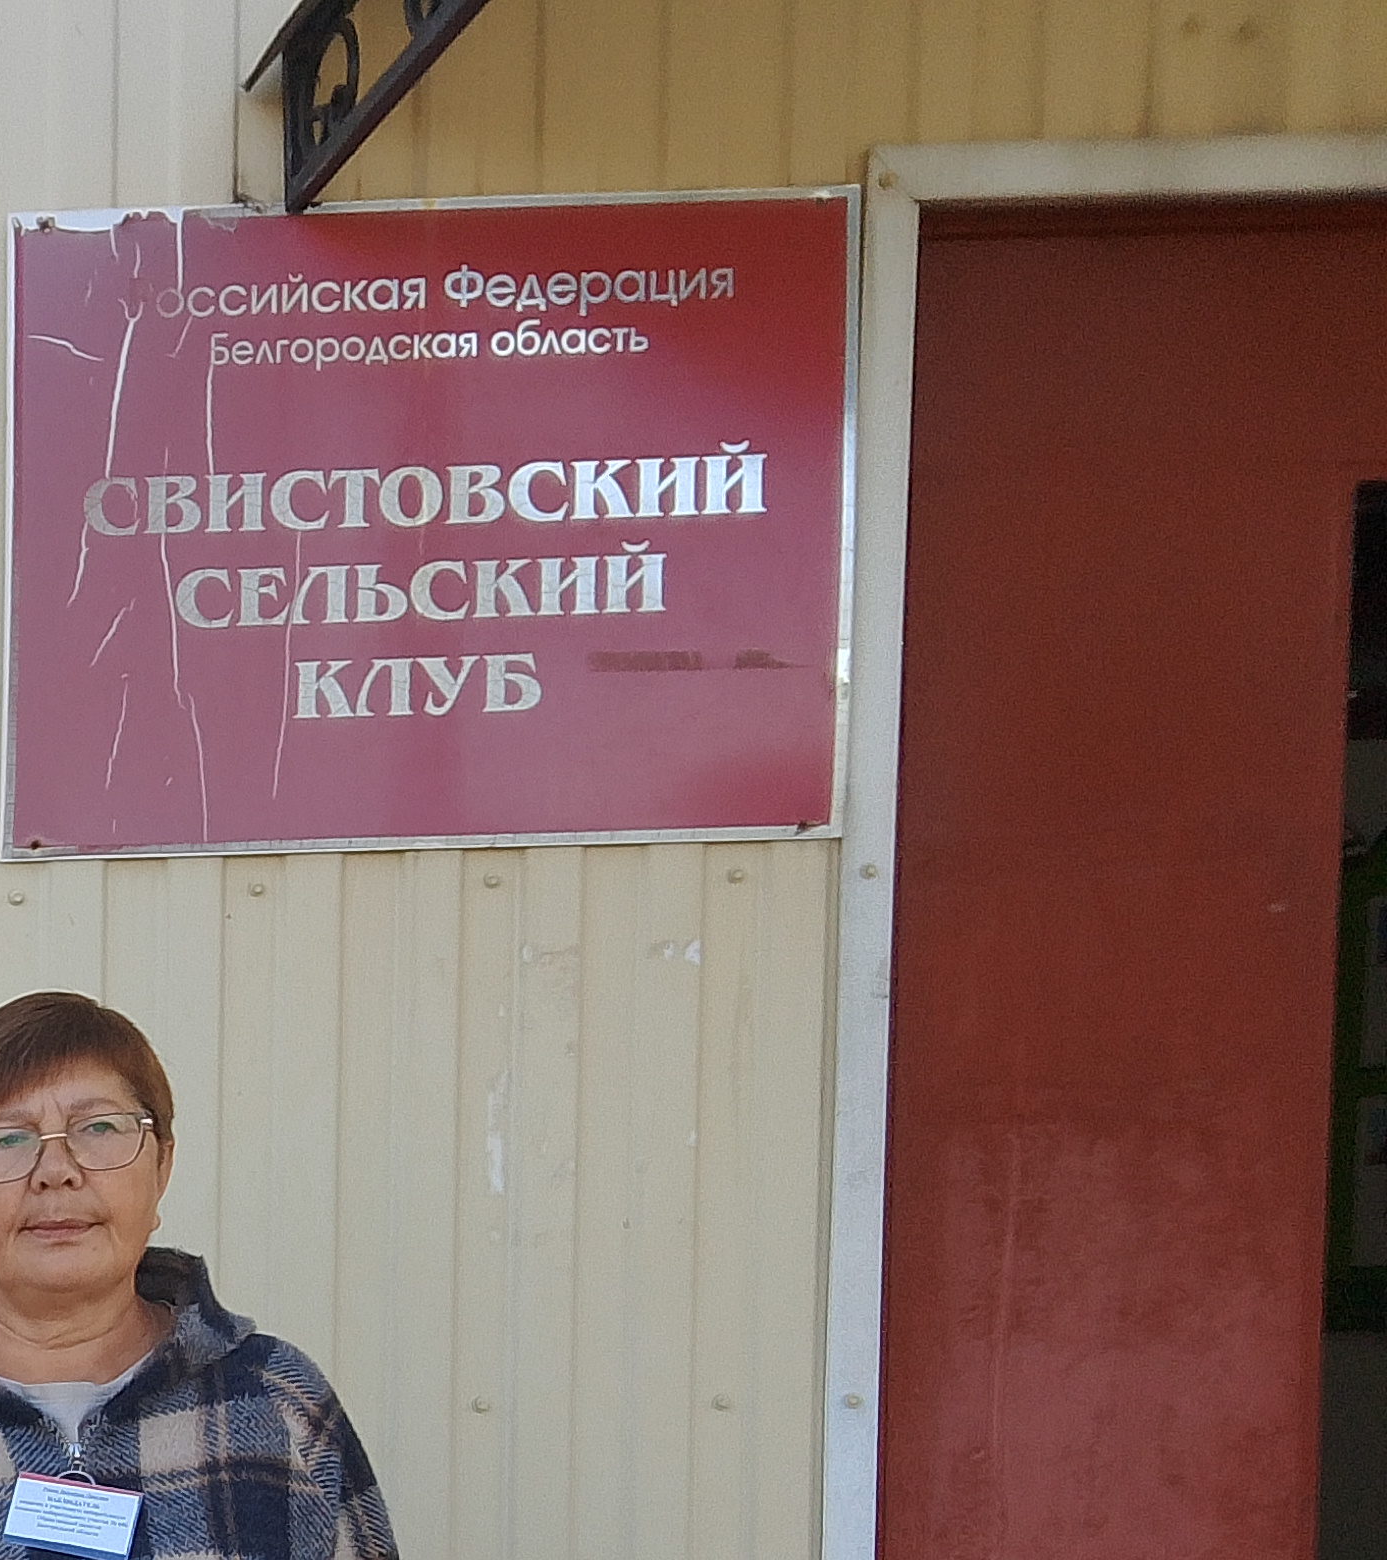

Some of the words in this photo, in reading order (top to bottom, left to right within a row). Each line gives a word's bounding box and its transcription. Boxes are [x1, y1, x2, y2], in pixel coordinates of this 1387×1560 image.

[156, 274, 427, 318] оссийская
[443, 264, 736, 316] Федерация
[210, 331, 479, 370] Белгородская
[490, 319, 650, 357] область
[84, 440, 768, 537] СВИСТОВСКИЙ
[175, 540, 668, 628] СЕЛЬСКИЙ
[293, 653, 543, 719] КЛУБ
